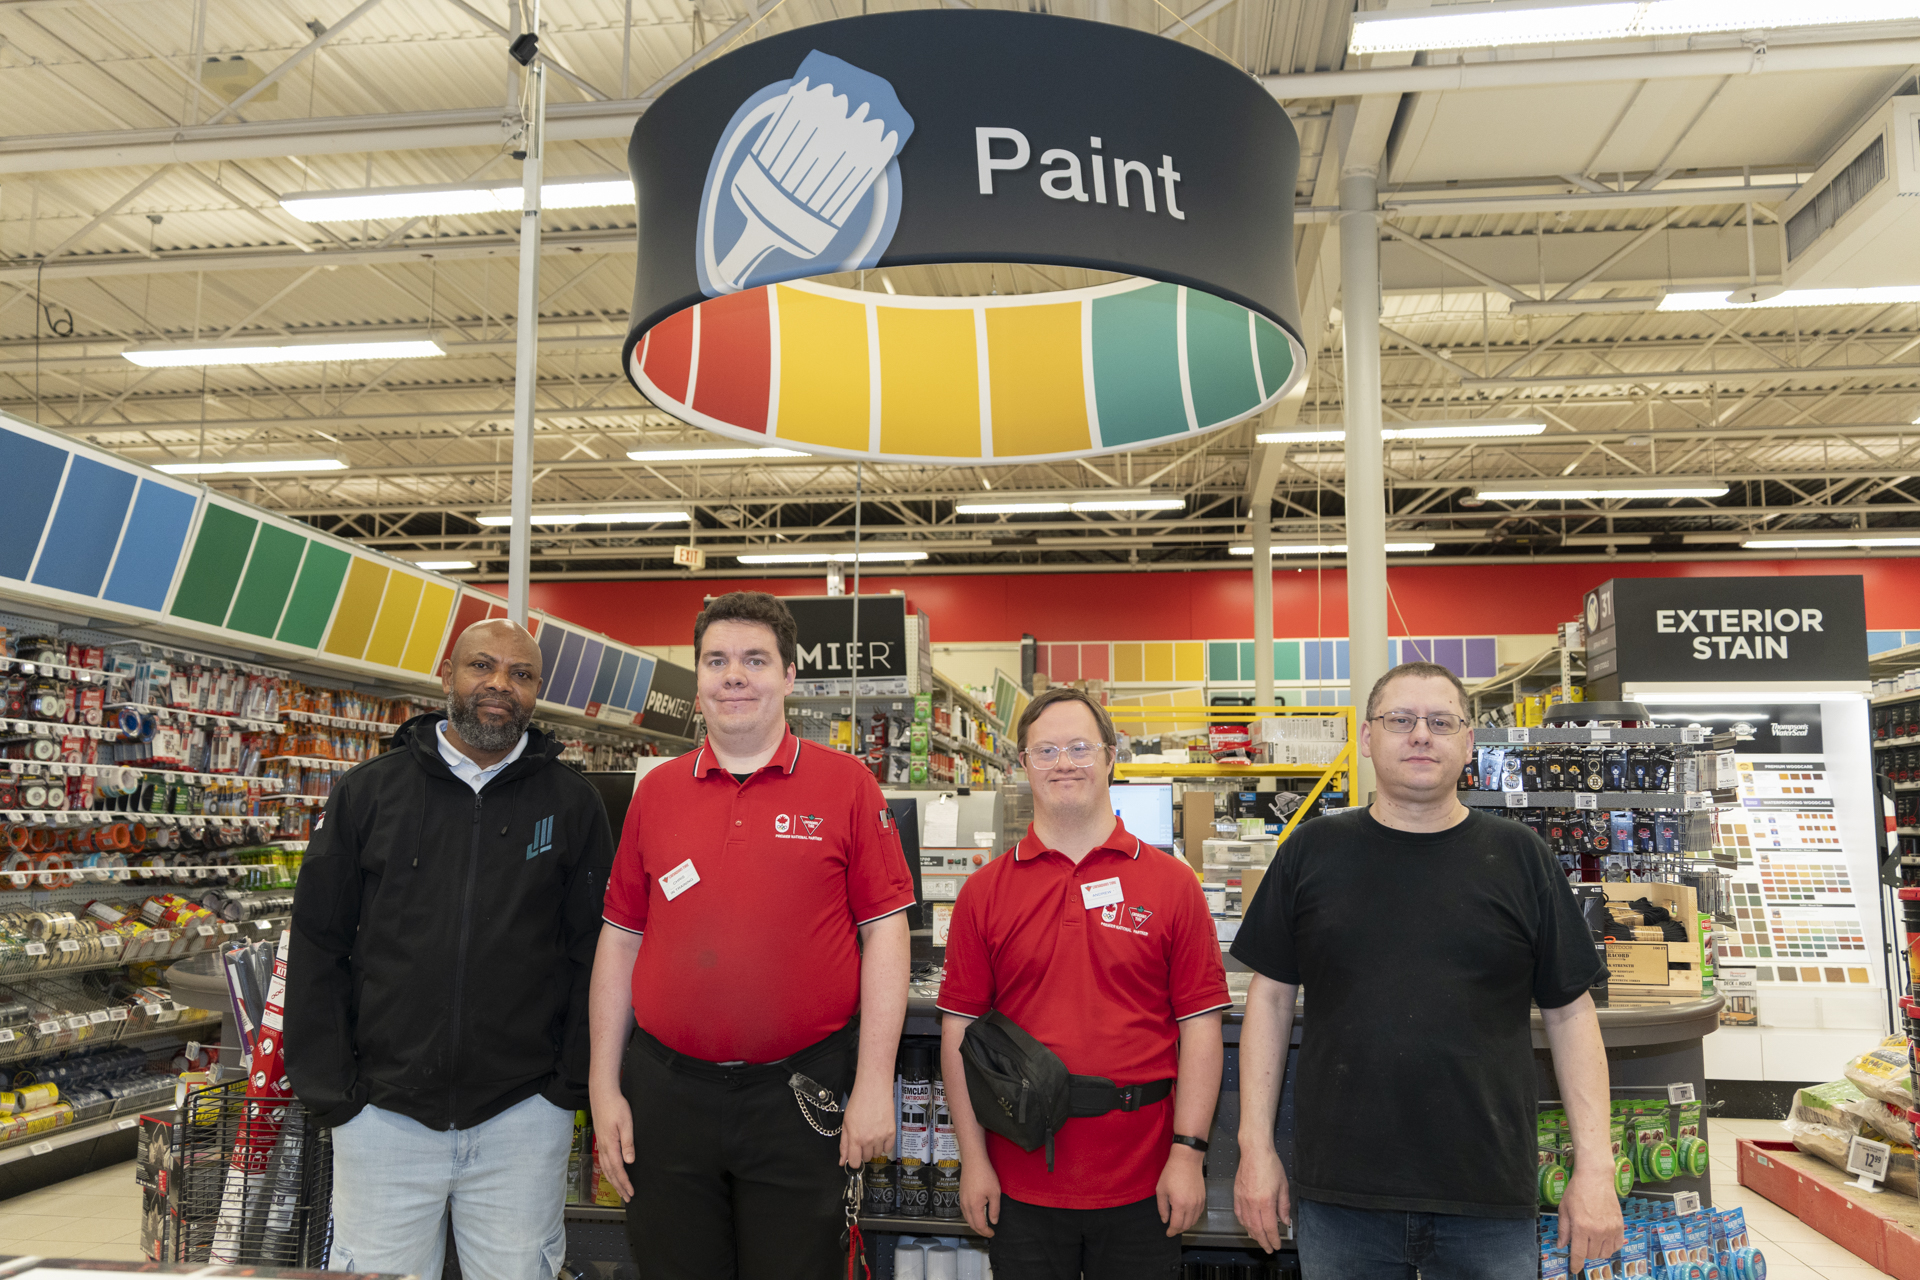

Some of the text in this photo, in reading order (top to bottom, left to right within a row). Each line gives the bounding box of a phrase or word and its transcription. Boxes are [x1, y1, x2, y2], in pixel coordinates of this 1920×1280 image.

[975, 127, 1185, 220] Paint
[680, 548, 698, 564] EXIT
[1601, 591, 1611, 618] 31
[1656, 608, 1824, 633] EXTERIOR
[1692, 636, 1788, 660] STAIN
[796, 642, 891, 670] MIER
[646, 690, 691, 720] PREMIER
[1116, 925, 1132, 933] NATIONAL
[261, 1026, 278, 1037] INCLUDES
[902, 1086, 928, 1095] REMCLAD
[938, 1159, 959, 1168] TURBO
[597, 1188, 610, 1198] Tape
[1688, 1233, 1700, 1241] HEALTHY
[1624, 1245, 1637, 1253] HEALTHY
[1544, 1259, 1557, 1268] HEALTHY
